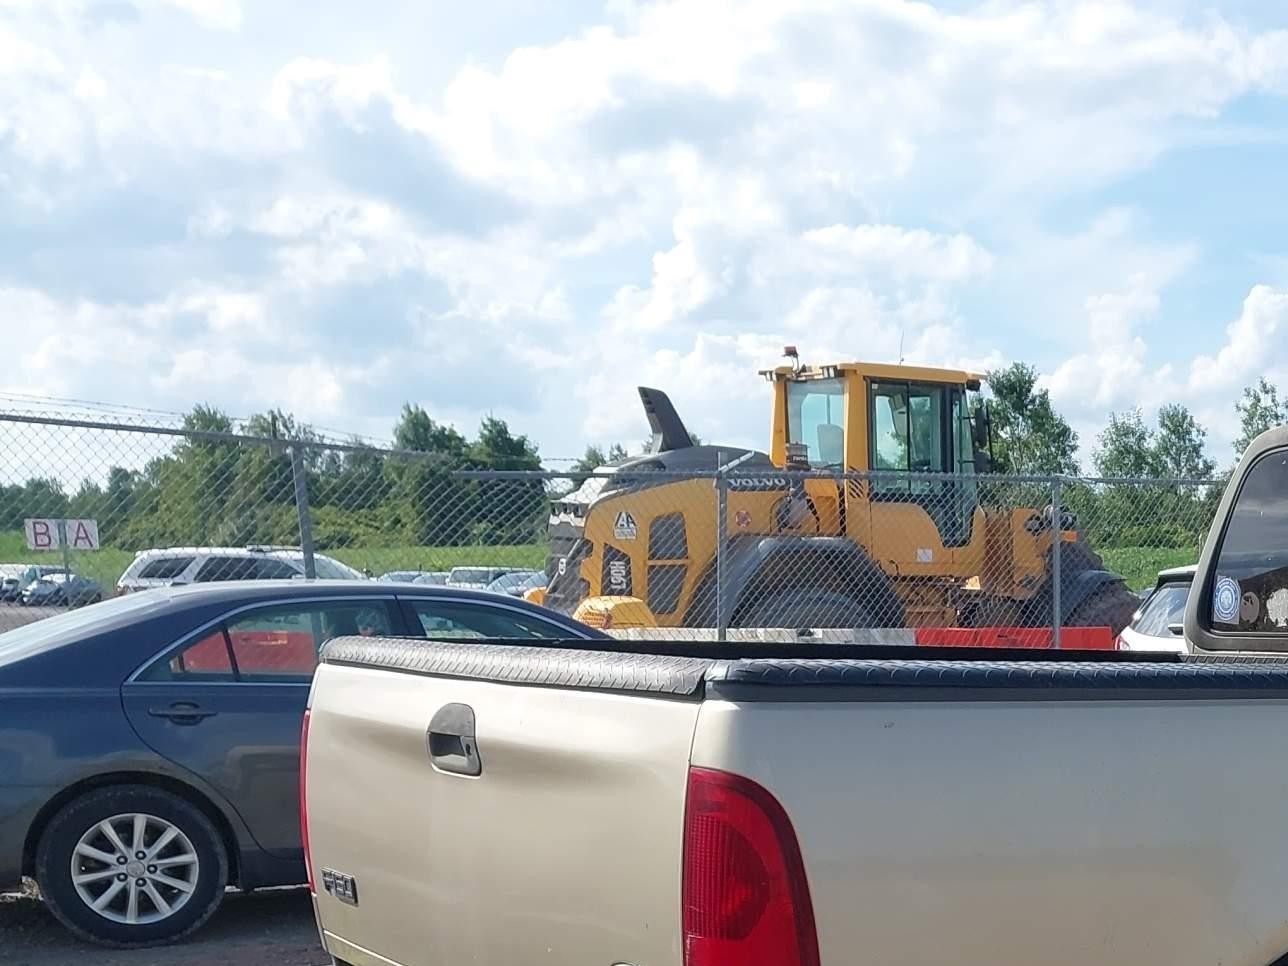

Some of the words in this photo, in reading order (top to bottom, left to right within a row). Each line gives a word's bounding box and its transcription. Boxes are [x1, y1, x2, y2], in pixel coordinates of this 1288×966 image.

[727, 477, 786, 488] VOLVO
[32, 521, 52, 548] B
[73, 522, 94, 548] A
